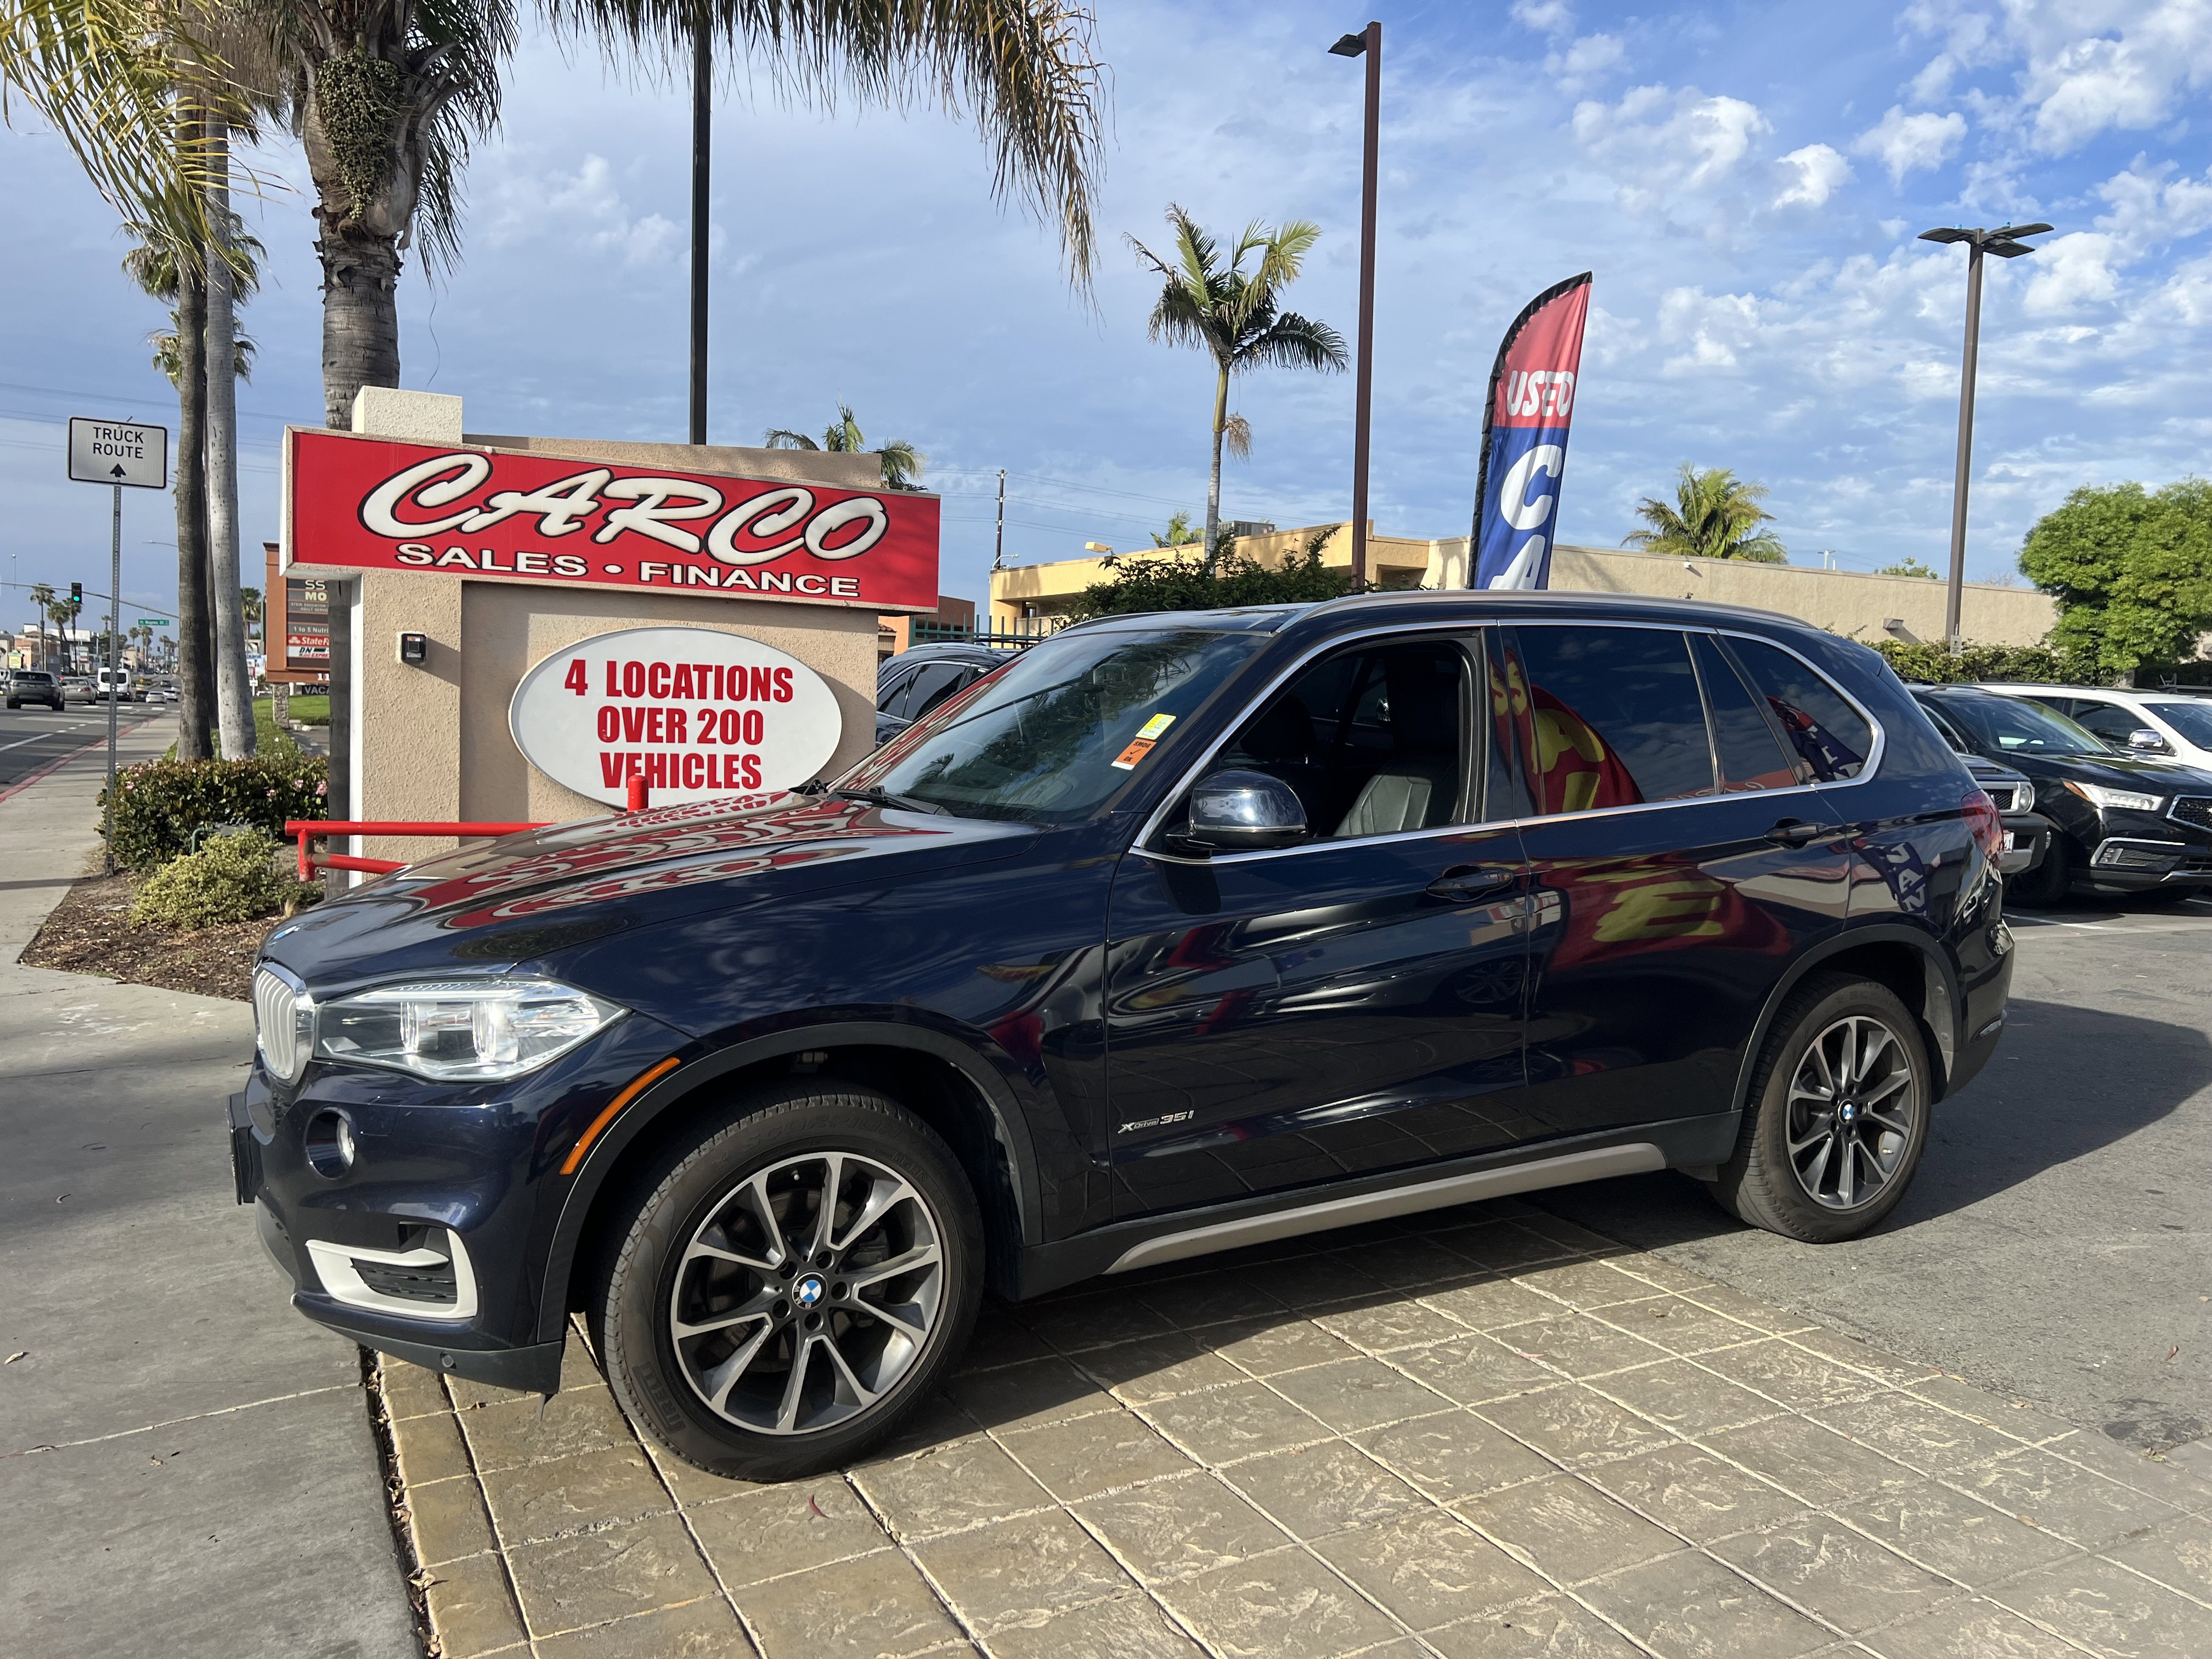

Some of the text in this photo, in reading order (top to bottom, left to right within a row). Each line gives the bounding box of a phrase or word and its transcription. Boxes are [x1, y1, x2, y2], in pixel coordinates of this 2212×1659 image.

[1505, 370, 1575, 417] USED
[93, 427, 144, 444] TRUCK
[93, 443, 144, 459] ROUTE
[358, 453, 890, 566] CARCO
[396, 543, 861, 598] SALES FINANCE
[565, 659, 793, 703] 4 LOCATIONS
[597, 706, 764, 745] OVER 200
[600, 752, 762, 789] VEHICLES
